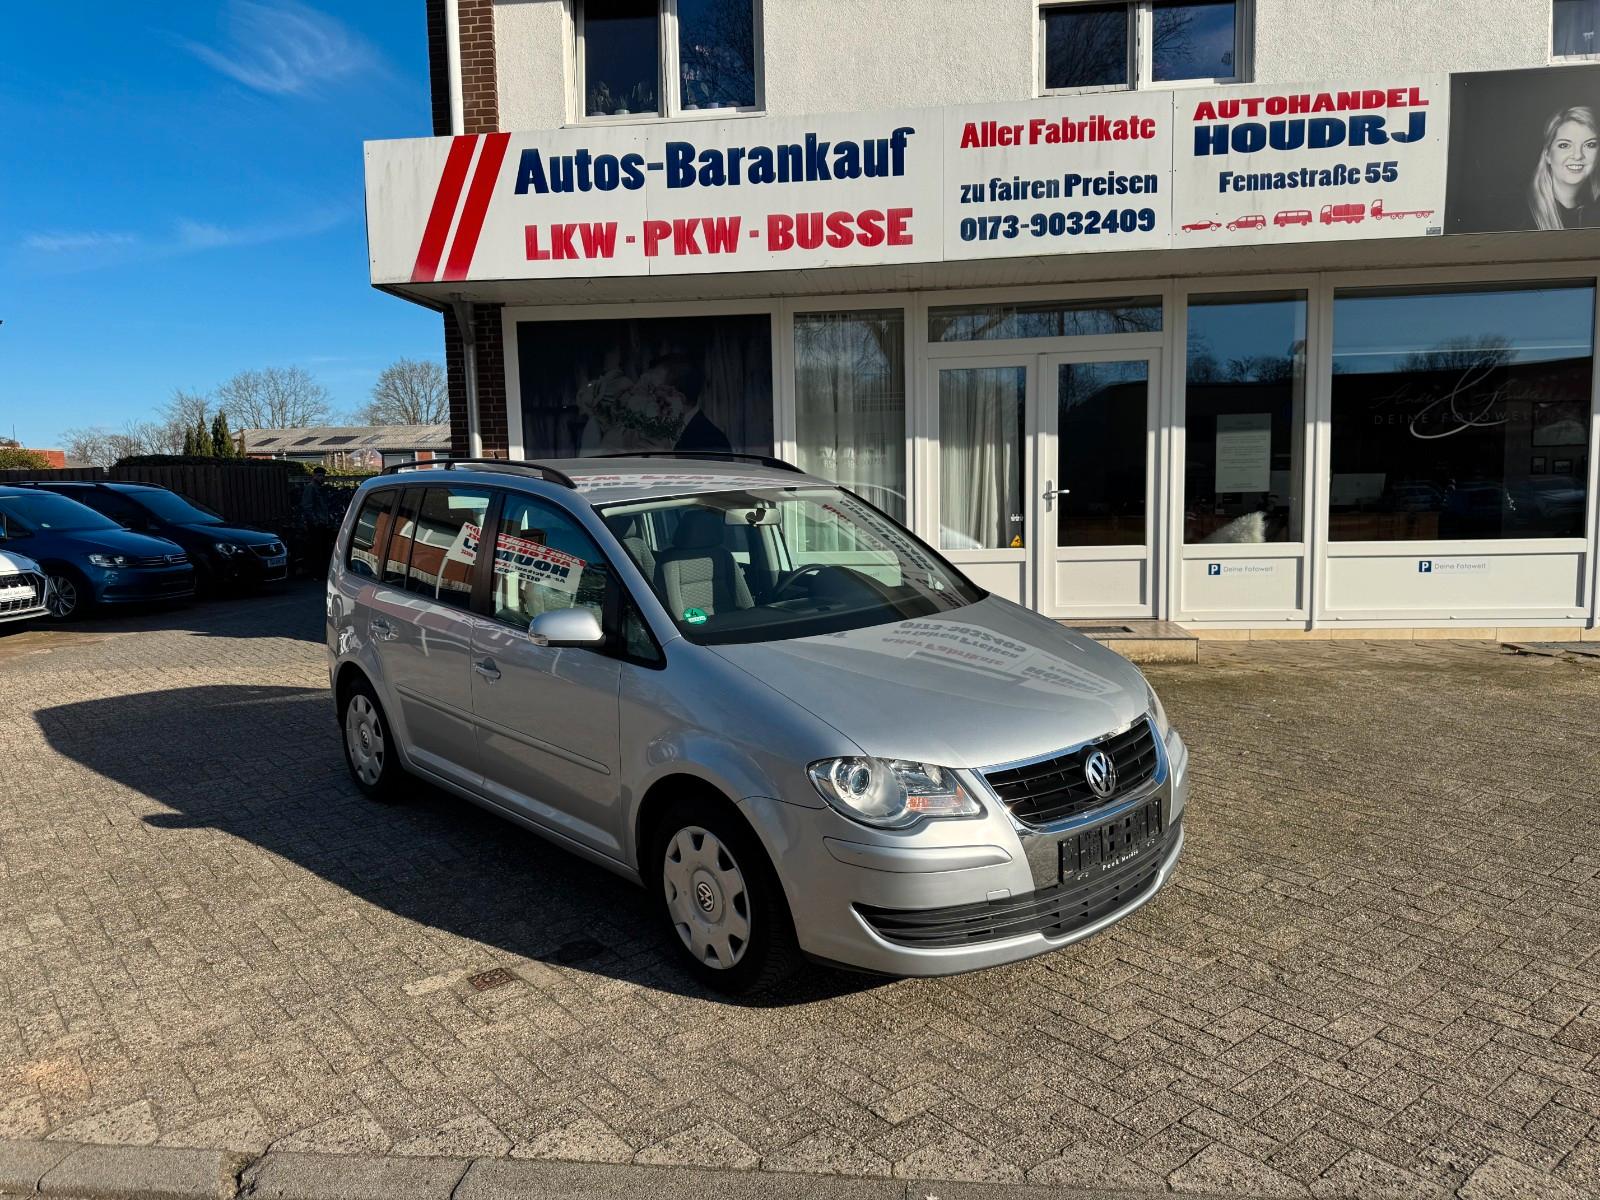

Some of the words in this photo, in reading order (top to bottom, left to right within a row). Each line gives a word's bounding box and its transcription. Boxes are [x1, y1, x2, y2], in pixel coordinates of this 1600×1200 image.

[1194, 87, 1429, 122] AUTOHANDEL
[960, 120, 1025, 150] Aller
[1028, 114, 1157, 146] Fabrikate
[1194, 111, 1427, 157] HOUDRJ
[514, 126, 916, 195] Autos-Barankauf
[1219, 164, 1361, 194] Fennastraße
[1364, 161, 1398, 184] 55
[960, 182, 986, 204] zu
[988, 175, 1061, 203] fairen
[1064, 170, 1158, 199] Preisen
[524, 221, 618, 262] LKW
[643, 215, 742, 257] PKW
[767, 207, 913, 252] BUSSE
[960, 207, 1156, 242] 0173-9032409
[1374, 413, 1429, 425] DEINE
